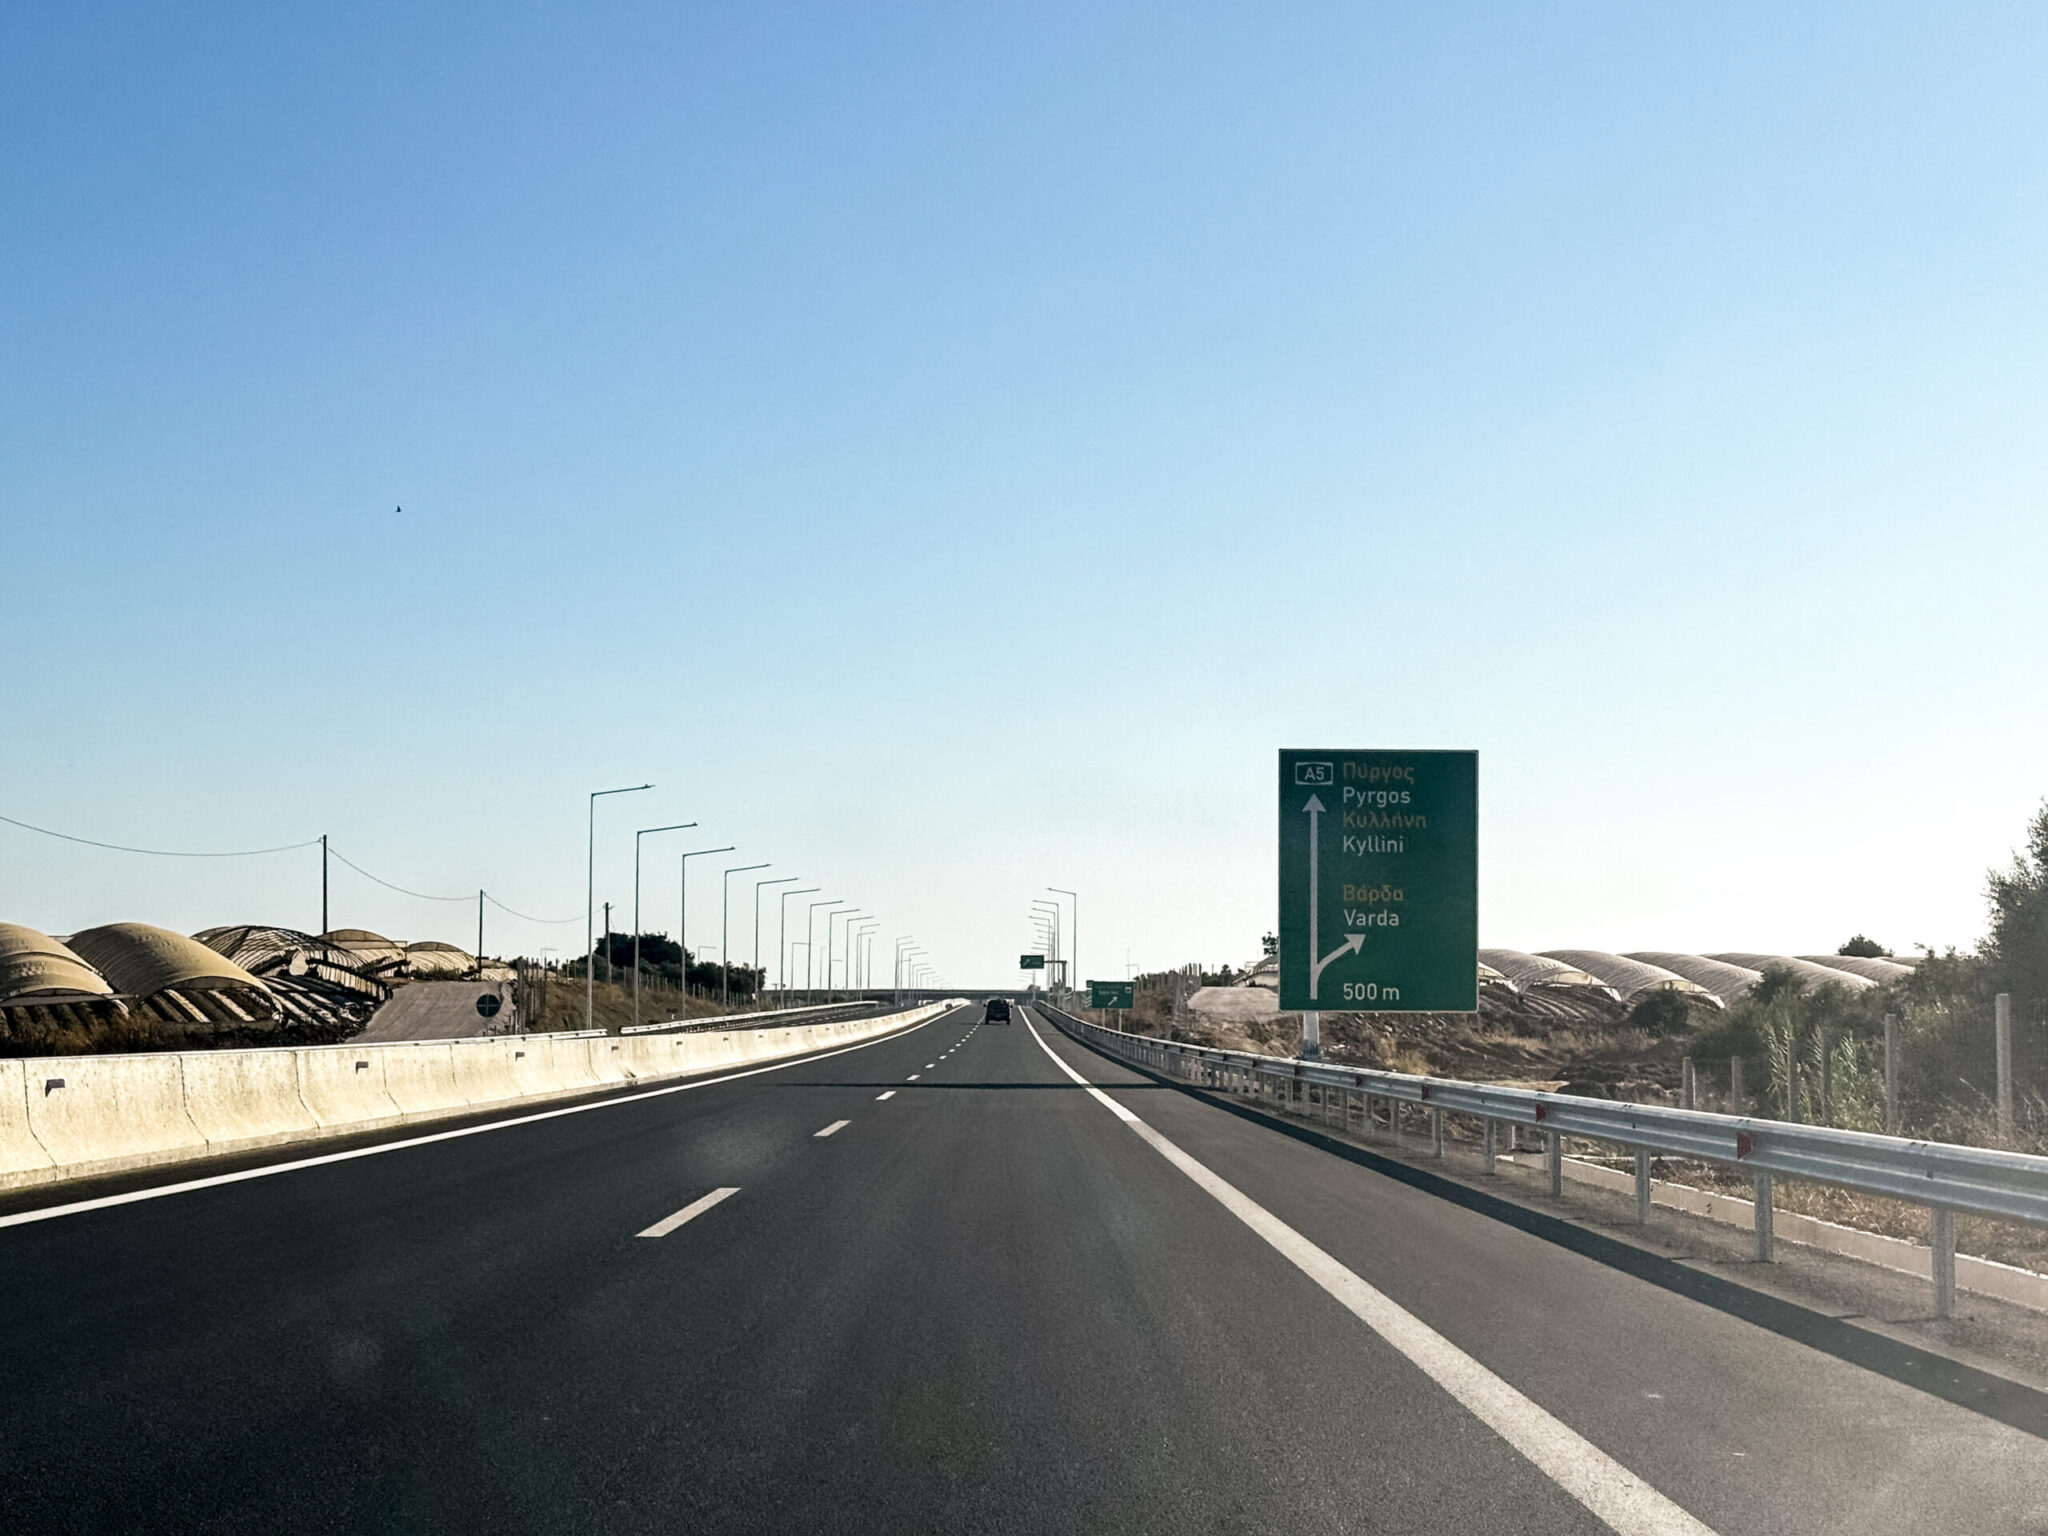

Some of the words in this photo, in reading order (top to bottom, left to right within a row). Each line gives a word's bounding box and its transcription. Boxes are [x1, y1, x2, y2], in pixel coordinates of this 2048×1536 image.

[1304, 767, 1325, 781] A5
[1343, 762, 1415, 785] Πύργος
[1343, 787, 1411, 808] Pyrgos
[1343, 811, 1427, 829] Κυλλήνη
[1343, 836, 1404, 856] Kyllini
[1343, 884, 1404, 905] Βάρδα
[1344, 909, 1400, 927] Varda
[1343, 983, 1378, 1001] 500
[1383, 987, 1400, 1001] m
